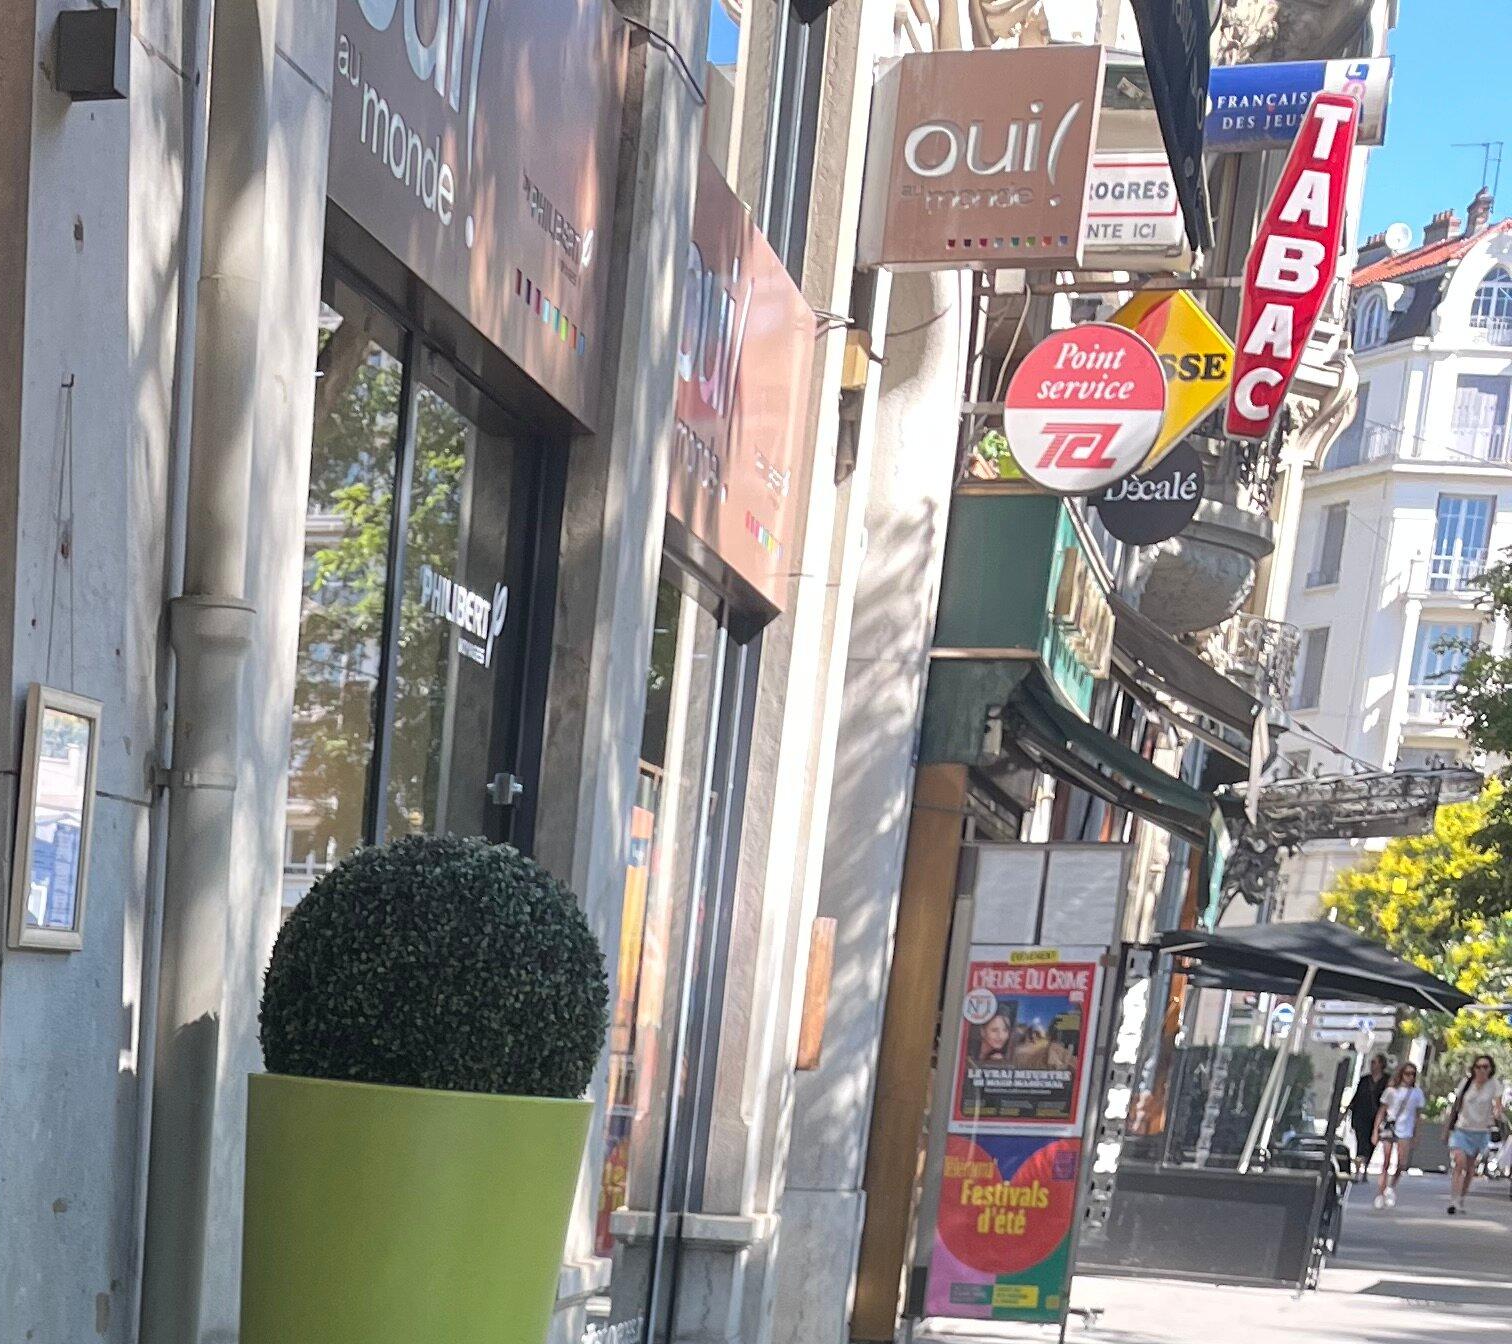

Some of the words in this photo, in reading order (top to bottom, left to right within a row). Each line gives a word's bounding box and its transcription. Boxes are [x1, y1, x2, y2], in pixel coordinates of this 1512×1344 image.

[337, 34, 362, 88] au
[1222, 116, 1256, 130] DES
[360, 83, 456, 226] monde
[1089, 180, 1170, 200] OGRES
[1086, 223, 1123, 239] NTE
[1133, 223, 1157, 239] ICI
[1234, 104, 1354, 422] TABAC
[1054, 344, 1128, 370] Point
[1160, 353, 1228, 382] SSE
[1037, 372, 1137, 401] service
[420, 563, 492, 641] PHILIBERT
[960, 1180, 1050, 1208] Festivals
[977, 1206, 1027, 1235] d'été
